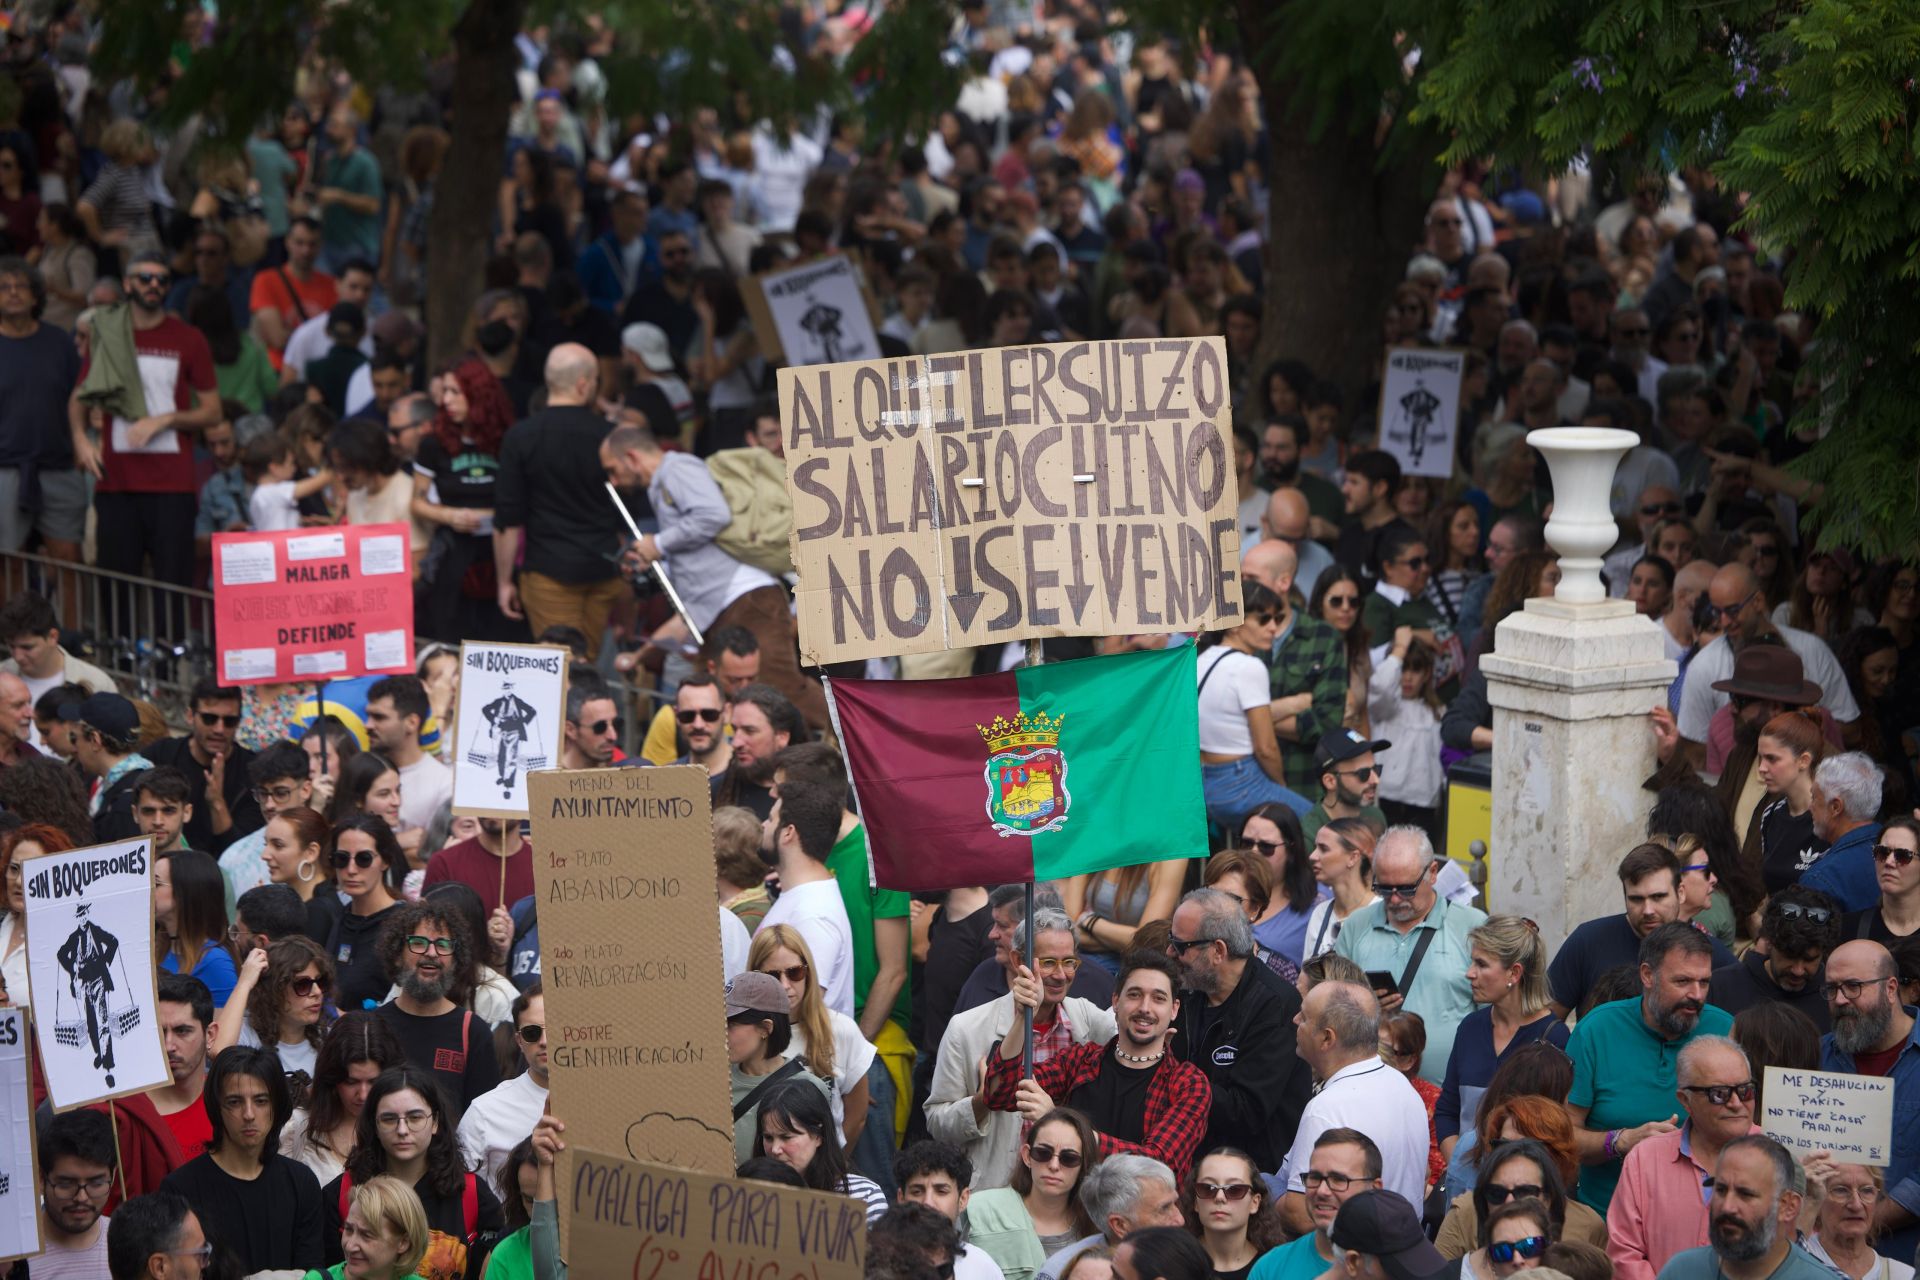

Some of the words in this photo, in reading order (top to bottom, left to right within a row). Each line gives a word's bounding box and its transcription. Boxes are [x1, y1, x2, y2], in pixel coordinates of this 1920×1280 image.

[828, 546, 932, 645] NO
[1096, 518, 1240, 626] VENDE
[278, 621, 356, 645] DEFIENDE
[466, 651, 485, 670] SIN
[486, 650, 559, 675] BOQUERONES
[626, 775, 654, 791] DEL
[551, 796, 694, 819] AYUNTAMIENTO
[576, 850, 612, 868] PLATO
[28, 868, 50, 899] SIN
[52, 845, 146, 897] BOQUERONES
[550, 875, 680, 905] ABANDONO
[584, 944, 623, 960] PLATO
[553, 955, 688, 989] REVALORIZACIÓN
[563, 1024, 613, 1042] POSTRE
[553, 1041, 703, 1069] GENTRIFICACIÓN
[1783, 1073, 1803, 1088] ME
[1768, 1107, 1783, 1117] NO
[1801, 1120, 1831, 1134] PARA
[1797, 1137, 1812, 1148] LOS
[575, 1160, 689, 1239] MÁLAGA
[708, 1182, 781, 1249] PARA
